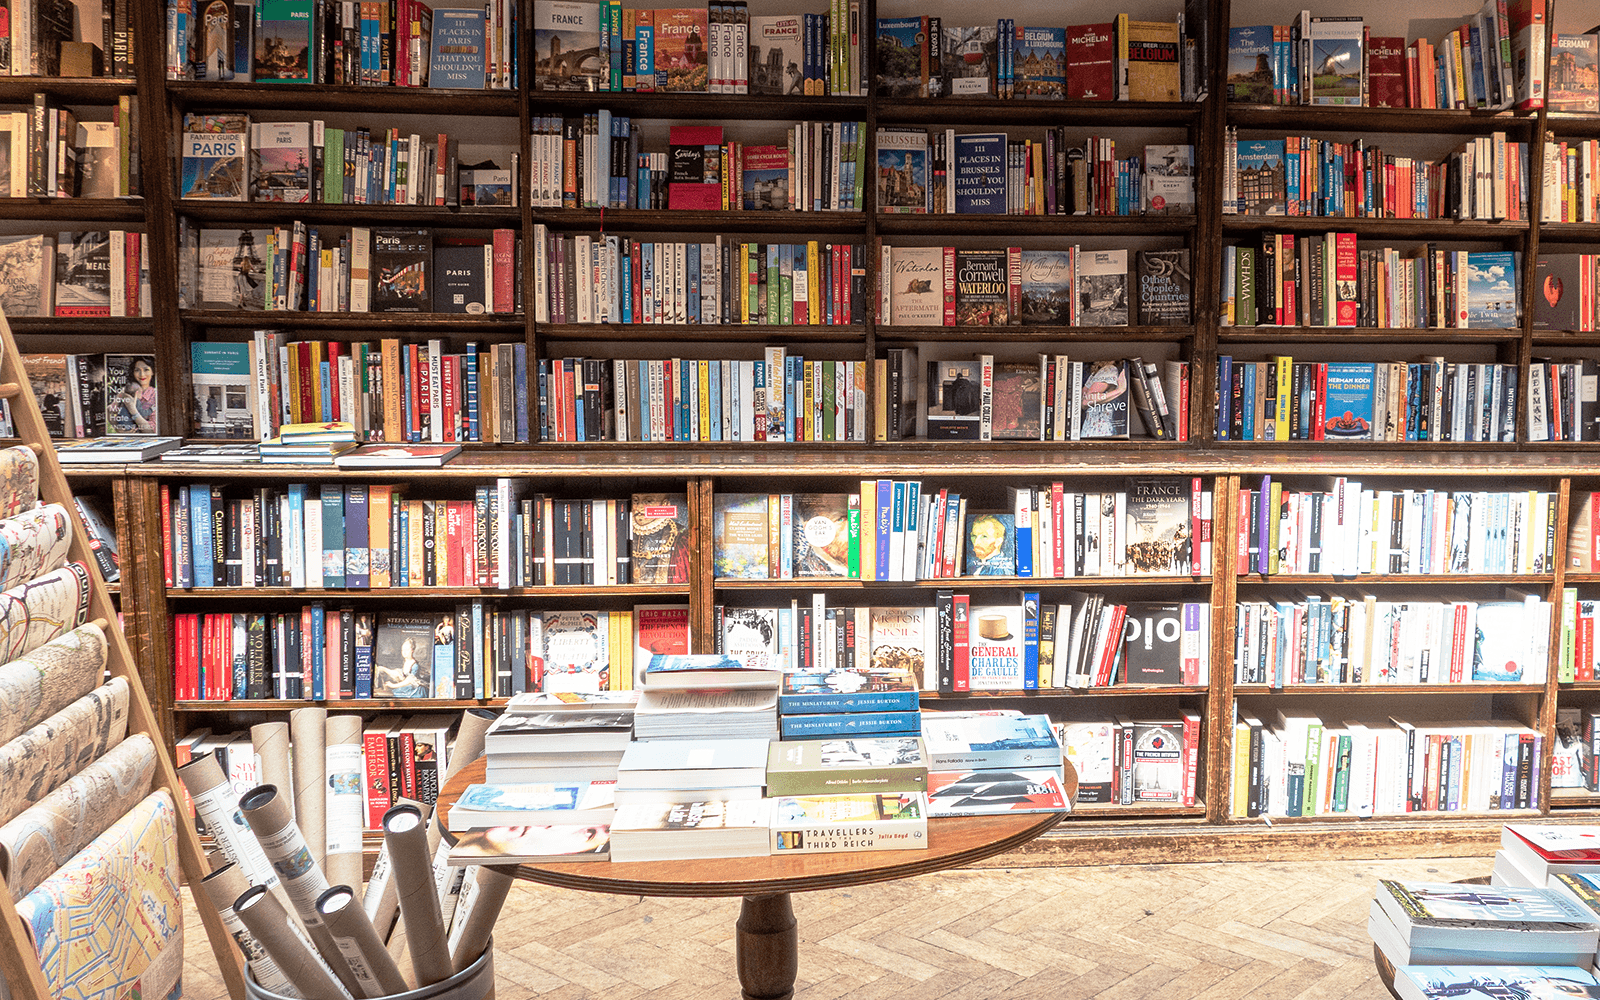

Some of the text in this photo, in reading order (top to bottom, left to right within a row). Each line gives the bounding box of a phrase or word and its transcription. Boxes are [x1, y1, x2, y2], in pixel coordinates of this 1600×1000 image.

[552, 14, 583, 25] FRANCE
[662, 24, 700, 34] France
[879, 21, 920, 29] Luxembourg
[438, 28, 481, 37] PLACES IN
[1024, 32, 1054, 41] BELGIUM
[447, 37, 471, 45] PARIS
[1071, 35, 1109, 44] MICHELIN
[1559, 39, 1591, 49] GERMANY
[114, 32, 127, 62] PARIS
[639, 30, 650, 70] France
[437, 55, 480, 63] THAT YOU
[1128, 48, 1175, 61] BELGIUM
[433, 64, 483, 72] SHOULDN'T
[214, 133, 240, 141] GUIDE
[878, 135, 926, 146] BRUSSELS
[192, 143, 236, 157] PARIS
[975, 145, 985, 153] 111
[959, 155, 1001, 164] PLACES IN
[960, 166, 1000, 174] BRUSSELS
[493, 175, 509, 183] Paris
[956, 176, 1004, 185] THAT YOU
[956, 186, 1005, 196] SHOULDN'T
[970, 197, 990, 206] MISS
[376, 236, 400, 245] Paris
[86, 262, 110, 271] MEALS
[894, 260, 939, 273] Waterloo
[966, 261, 997, 271] Bernard
[945, 255, 955, 290] WATERLOO
[959, 268, 1004, 282] Cornwell
[1241, 252, 1250, 300] SCHAMA
[1142, 275, 1170, 284] Other
[959, 283, 1005, 294] WATERLOO
[1142, 284, 1180, 293] People's
[1142, 293, 1189, 301] Countries
[773, 349, 782, 367] TOUR
[109, 367, 124, 375] You
[109, 376, 126, 384] Will
[773, 376, 782, 402] FRANCE
[110, 395, 130, 403] Have
[1082, 392, 1107, 400] Anita
[1087, 401, 1126, 412] Shreve
[1137, 487, 1180, 495] FRANCE
[202, 512, 210, 534] SWEET
[447, 509, 456, 536] Barker
[215, 510, 224, 563] CHARLEMAGNE
[477, 498, 486, 565] 1415 AGINCOURT
[871, 614, 921, 624] VICTOR
[846, 621, 854, 647] ASYLUM
[972, 647, 1019, 657] GENERAL
[254, 633, 264, 685] VOLTAIRE
[972, 657, 1018, 668] CHARLES
[972, 667, 1019, 676] DE GAULLE
[367, 738, 376, 777] EMPEROR
[376, 737, 385, 775] CITIZEN
[806, 828, 874, 837] TRAVELLERS
